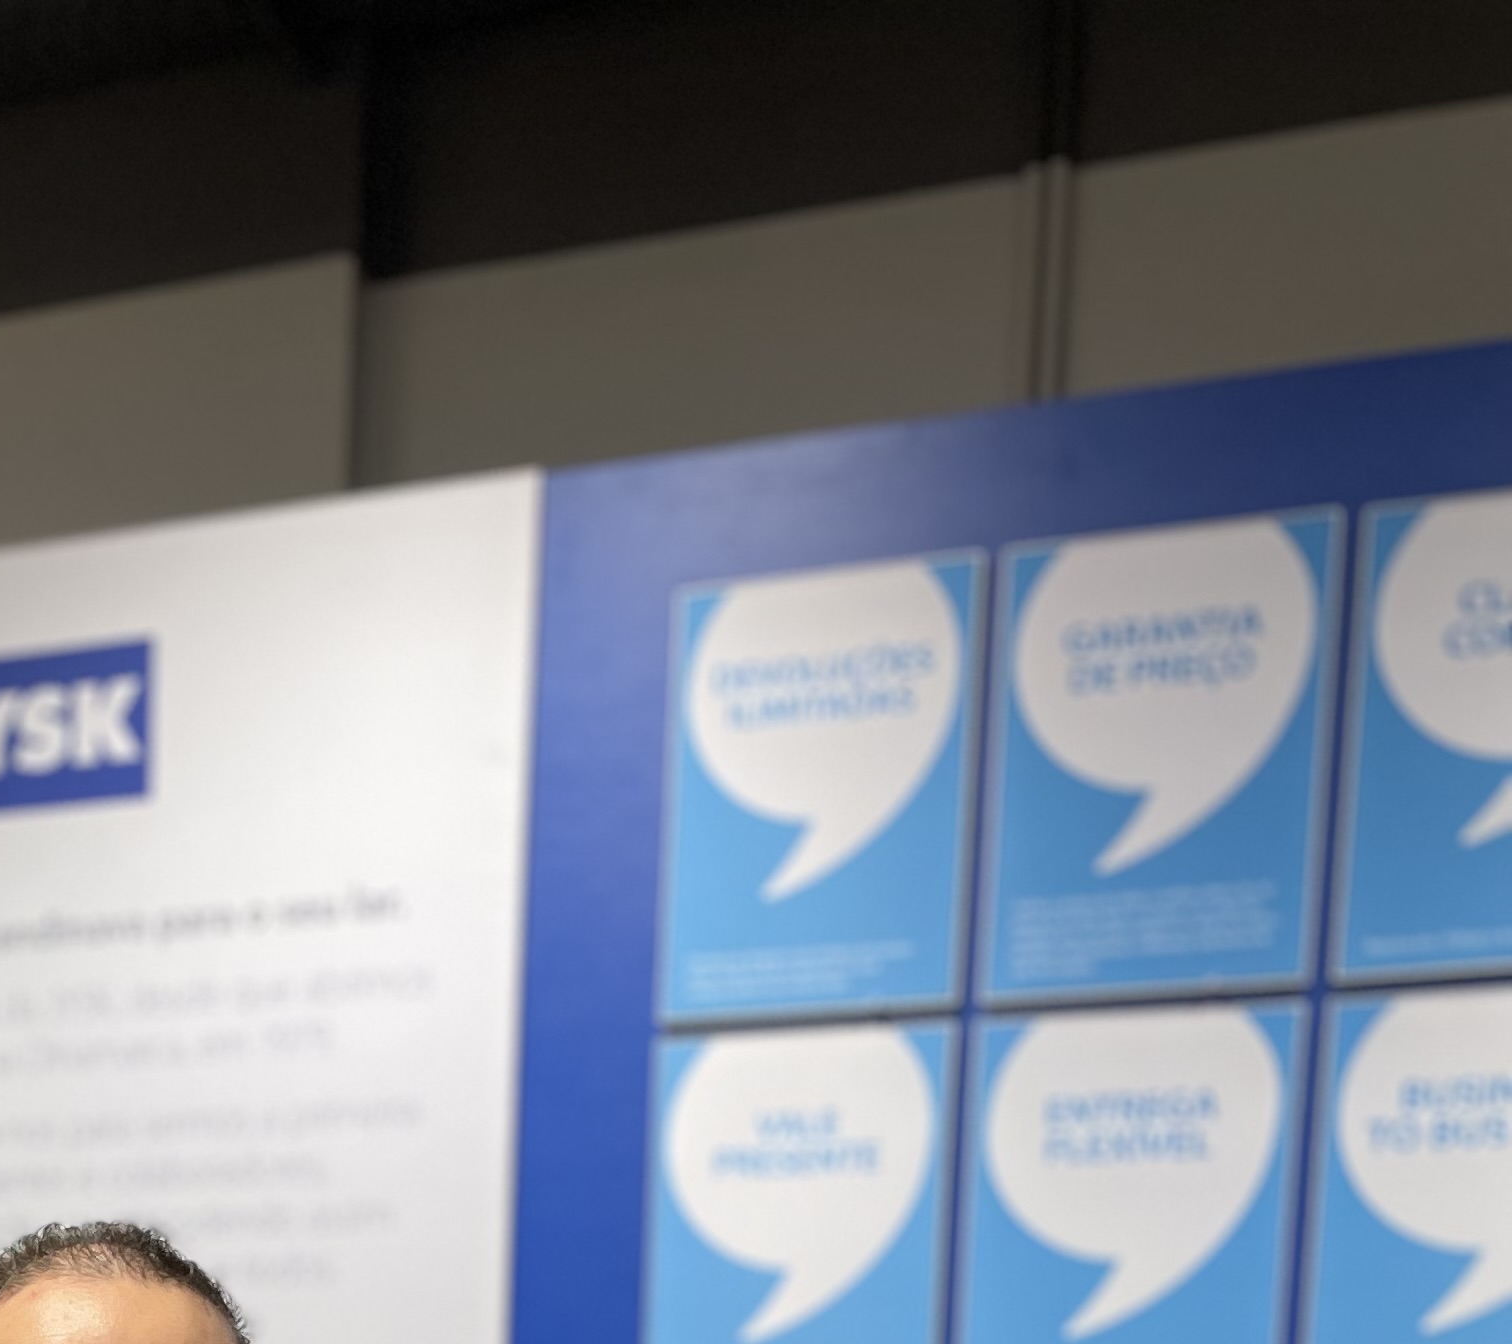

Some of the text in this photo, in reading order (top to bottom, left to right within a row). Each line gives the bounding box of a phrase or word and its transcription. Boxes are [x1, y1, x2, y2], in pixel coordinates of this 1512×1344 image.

[1063, 605, 1262, 654] GARANTIA
[1067, 643, 1255, 696] DE PREÇO
[1044, 1085, 1219, 1124] ENTREGA
